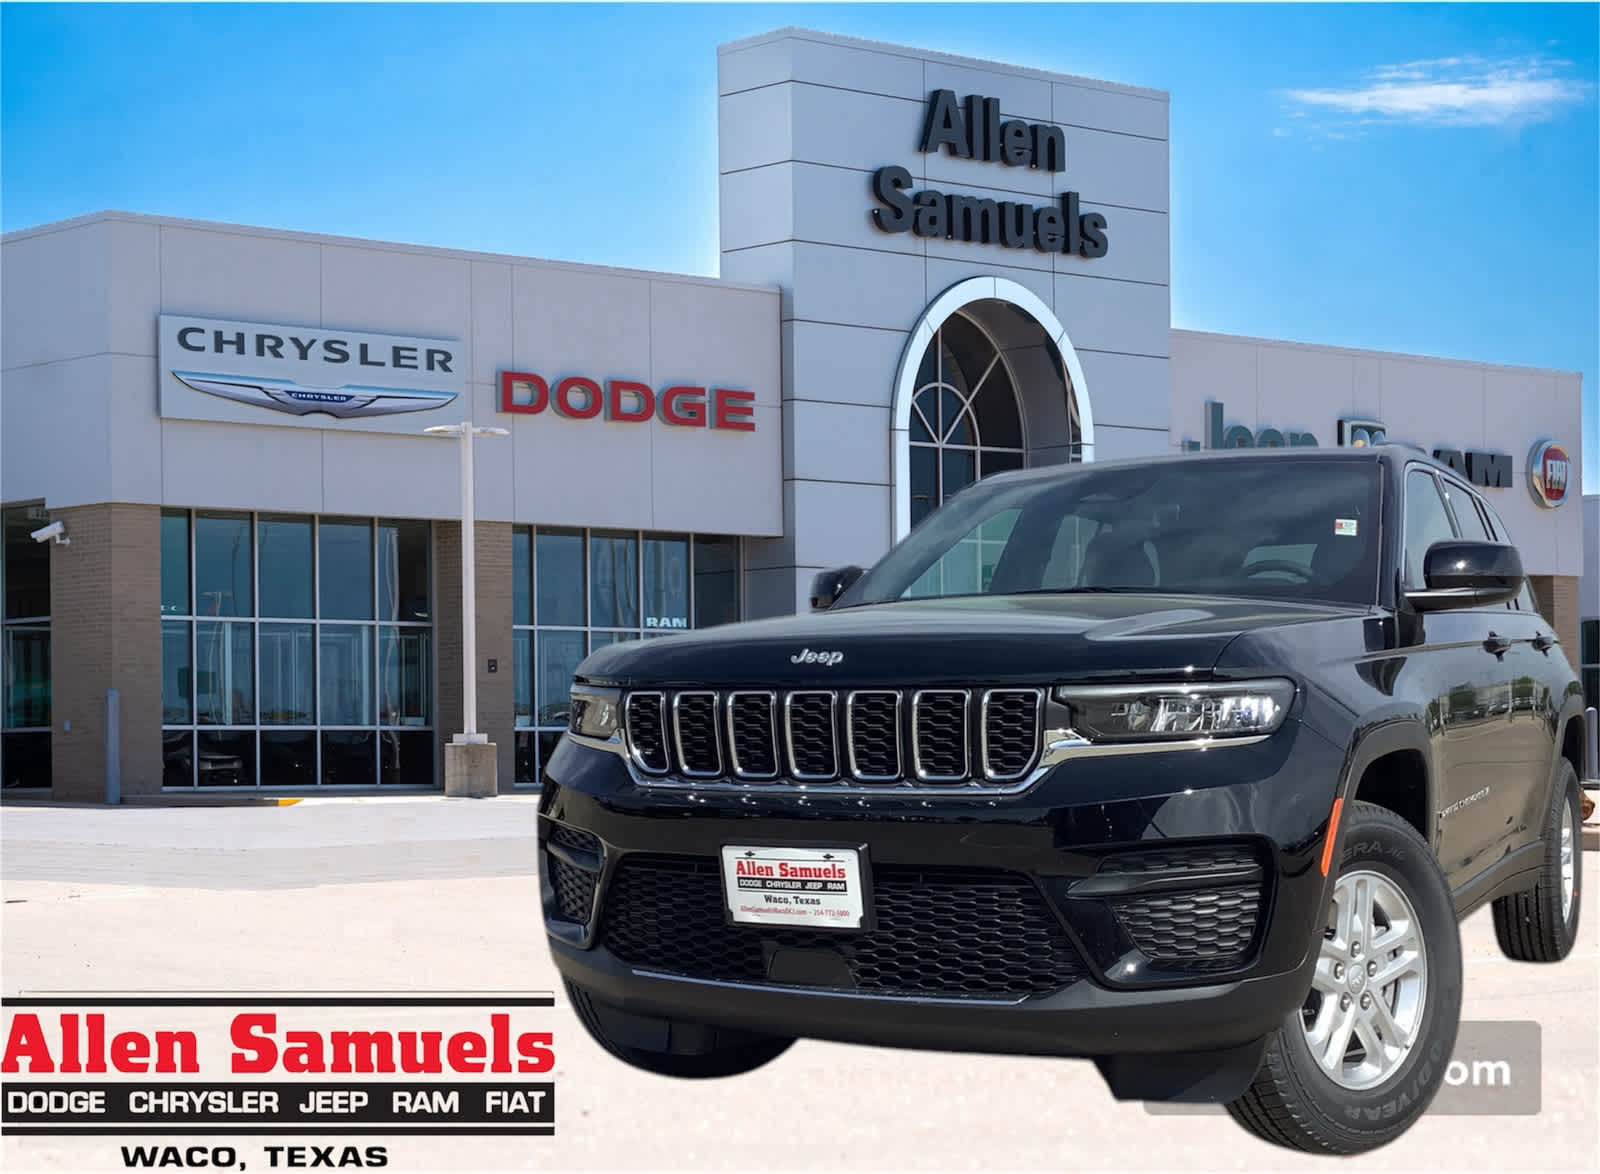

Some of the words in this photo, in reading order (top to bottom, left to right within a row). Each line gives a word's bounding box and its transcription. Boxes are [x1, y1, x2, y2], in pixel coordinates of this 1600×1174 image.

[919, 88, 1066, 172] Allen
[872, 165, 1109, 258] Samuels
[177, 326, 454, 373] CHRYSLER
[290, 392, 348, 402] CHRYSLER
[496, 370, 756, 432] DODGE
[1546, 459, 1567, 489] FIAT
[646, 616, 687, 628] RAM
[790, 648, 844, 667] Jeep
[735, 860, 774, 877] Allen
[778, 862, 846, 879] Samuels
[739, 879, 762, 888] DODGE
[766, 880, 802, 890] CHRYSLER
[804, 881, 823, 890] JEEP
[827, 882, 845, 891] RAM
[763, 894, 792, 905] Waco,
[793, 895, 821, 905] Texas
